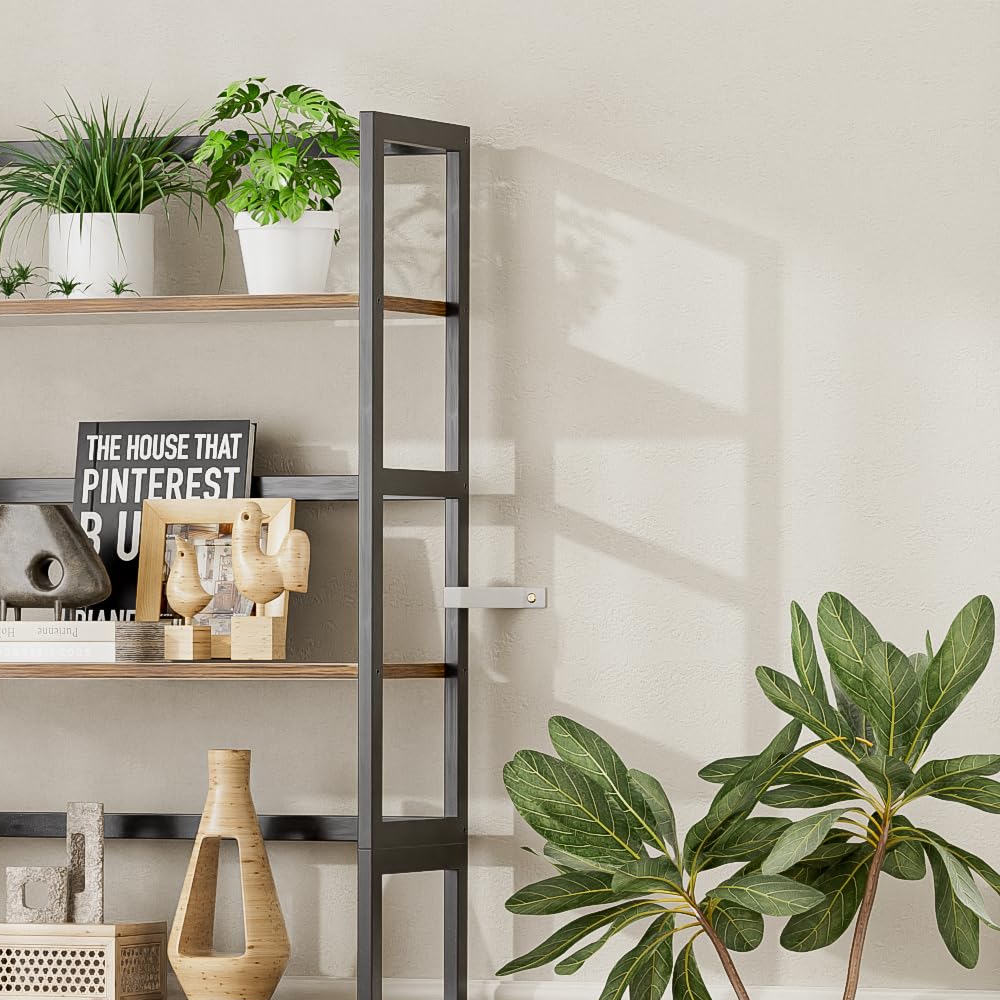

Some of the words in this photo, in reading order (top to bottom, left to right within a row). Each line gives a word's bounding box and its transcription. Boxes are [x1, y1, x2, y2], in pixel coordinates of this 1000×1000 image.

[86, 434, 122, 461] THE
[126, 433, 190, 461] HOUSE
[194, 433, 243, 460] THAT
[81, 466, 241, 504] PINTEREST
